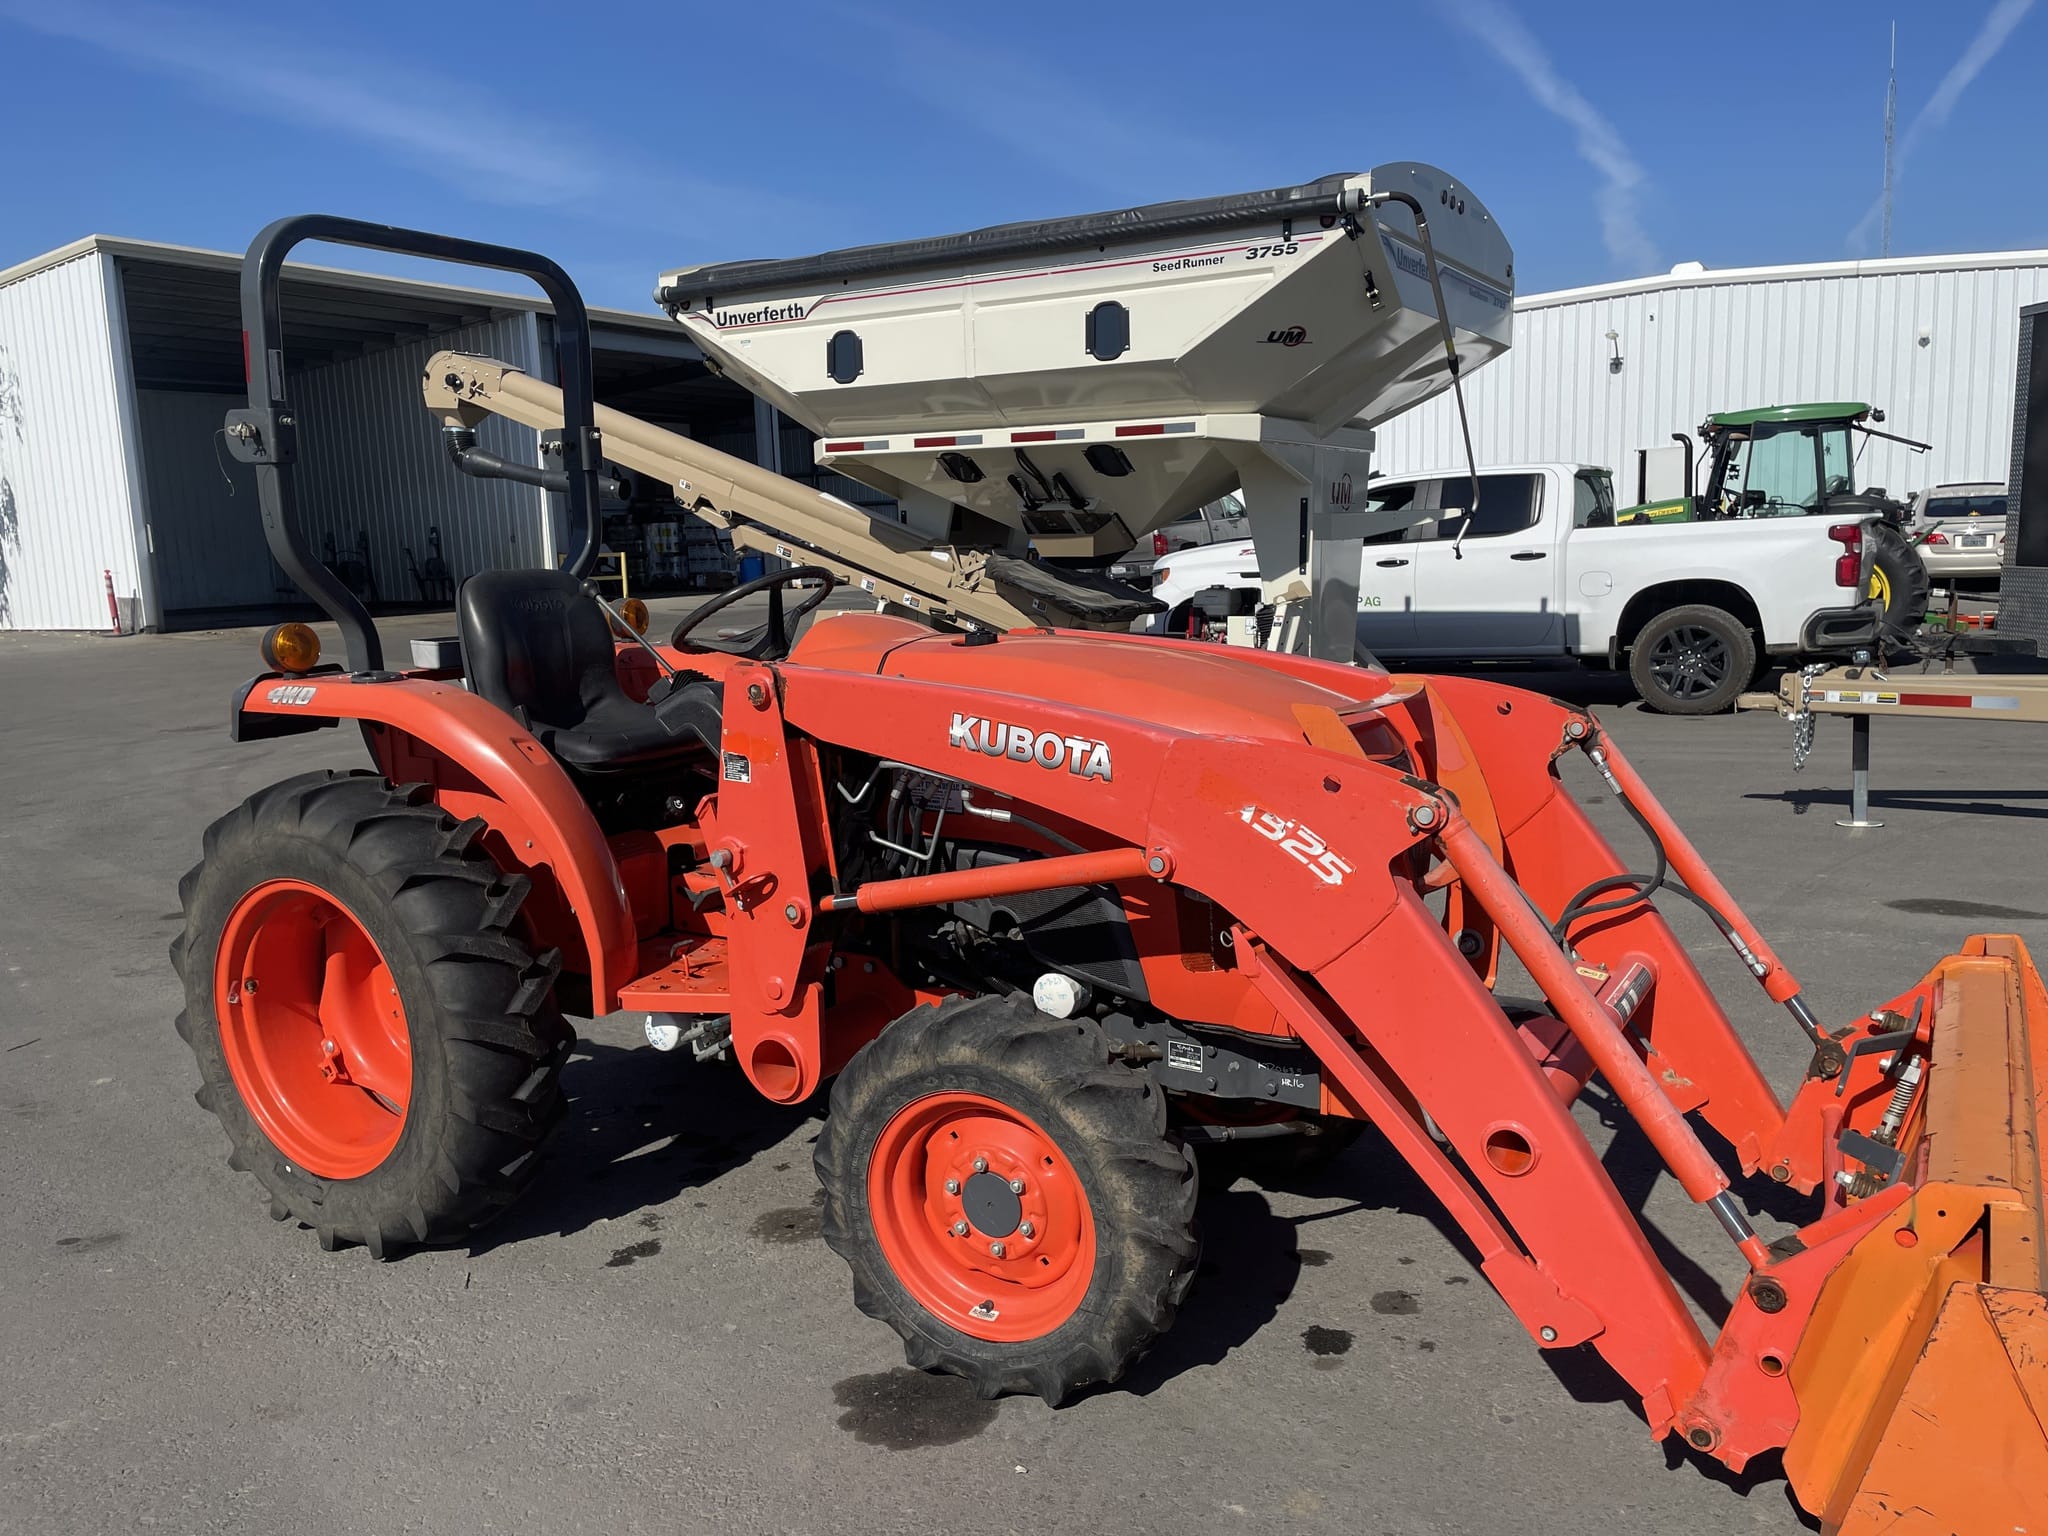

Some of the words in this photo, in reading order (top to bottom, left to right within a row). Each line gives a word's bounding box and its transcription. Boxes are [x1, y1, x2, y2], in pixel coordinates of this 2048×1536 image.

[1245, 242, 1299, 260] 3755
[716, 302, 804, 326] Unverferth
[267, 685, 318, 705] 4WD
[949, 712, 1113, 783] KUBOTA
